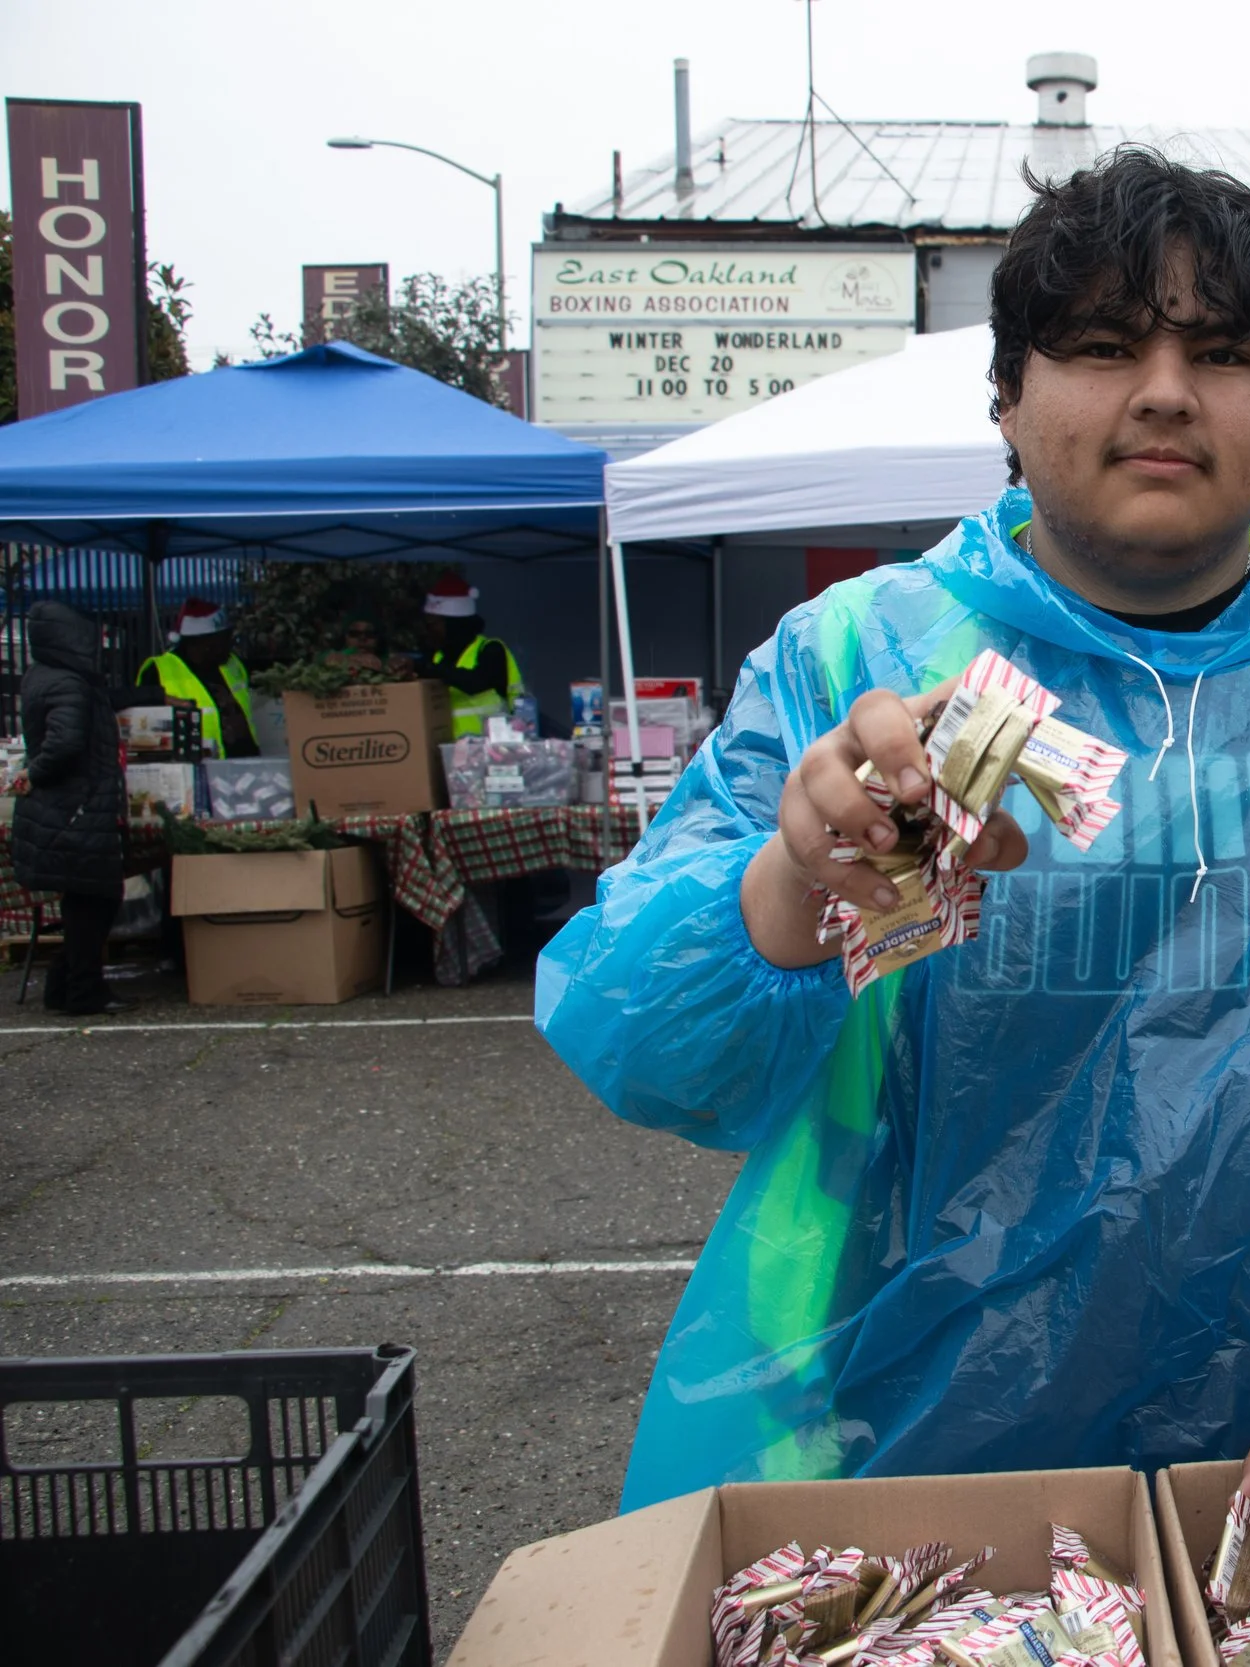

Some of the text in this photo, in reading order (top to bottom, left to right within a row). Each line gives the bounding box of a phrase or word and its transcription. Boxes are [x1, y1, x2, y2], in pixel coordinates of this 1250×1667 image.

[38, 157, 110, 392] HONOR
[556, 259, 798, 285] East Oakland
[550, 295, 791, 313] BOXING ASSOCIATION
[609, 332, 843, 349] WINTER WONDERLAND
[655, 355, 734, 372] DEC 20
[704, 379, 729, 396] TO
[314, 738, 398, 764] Sterilite
[868, 920, 940, 956] GHIRARDELLI
[1021, 1622, 1054, 1667] GHIRARDELLI
